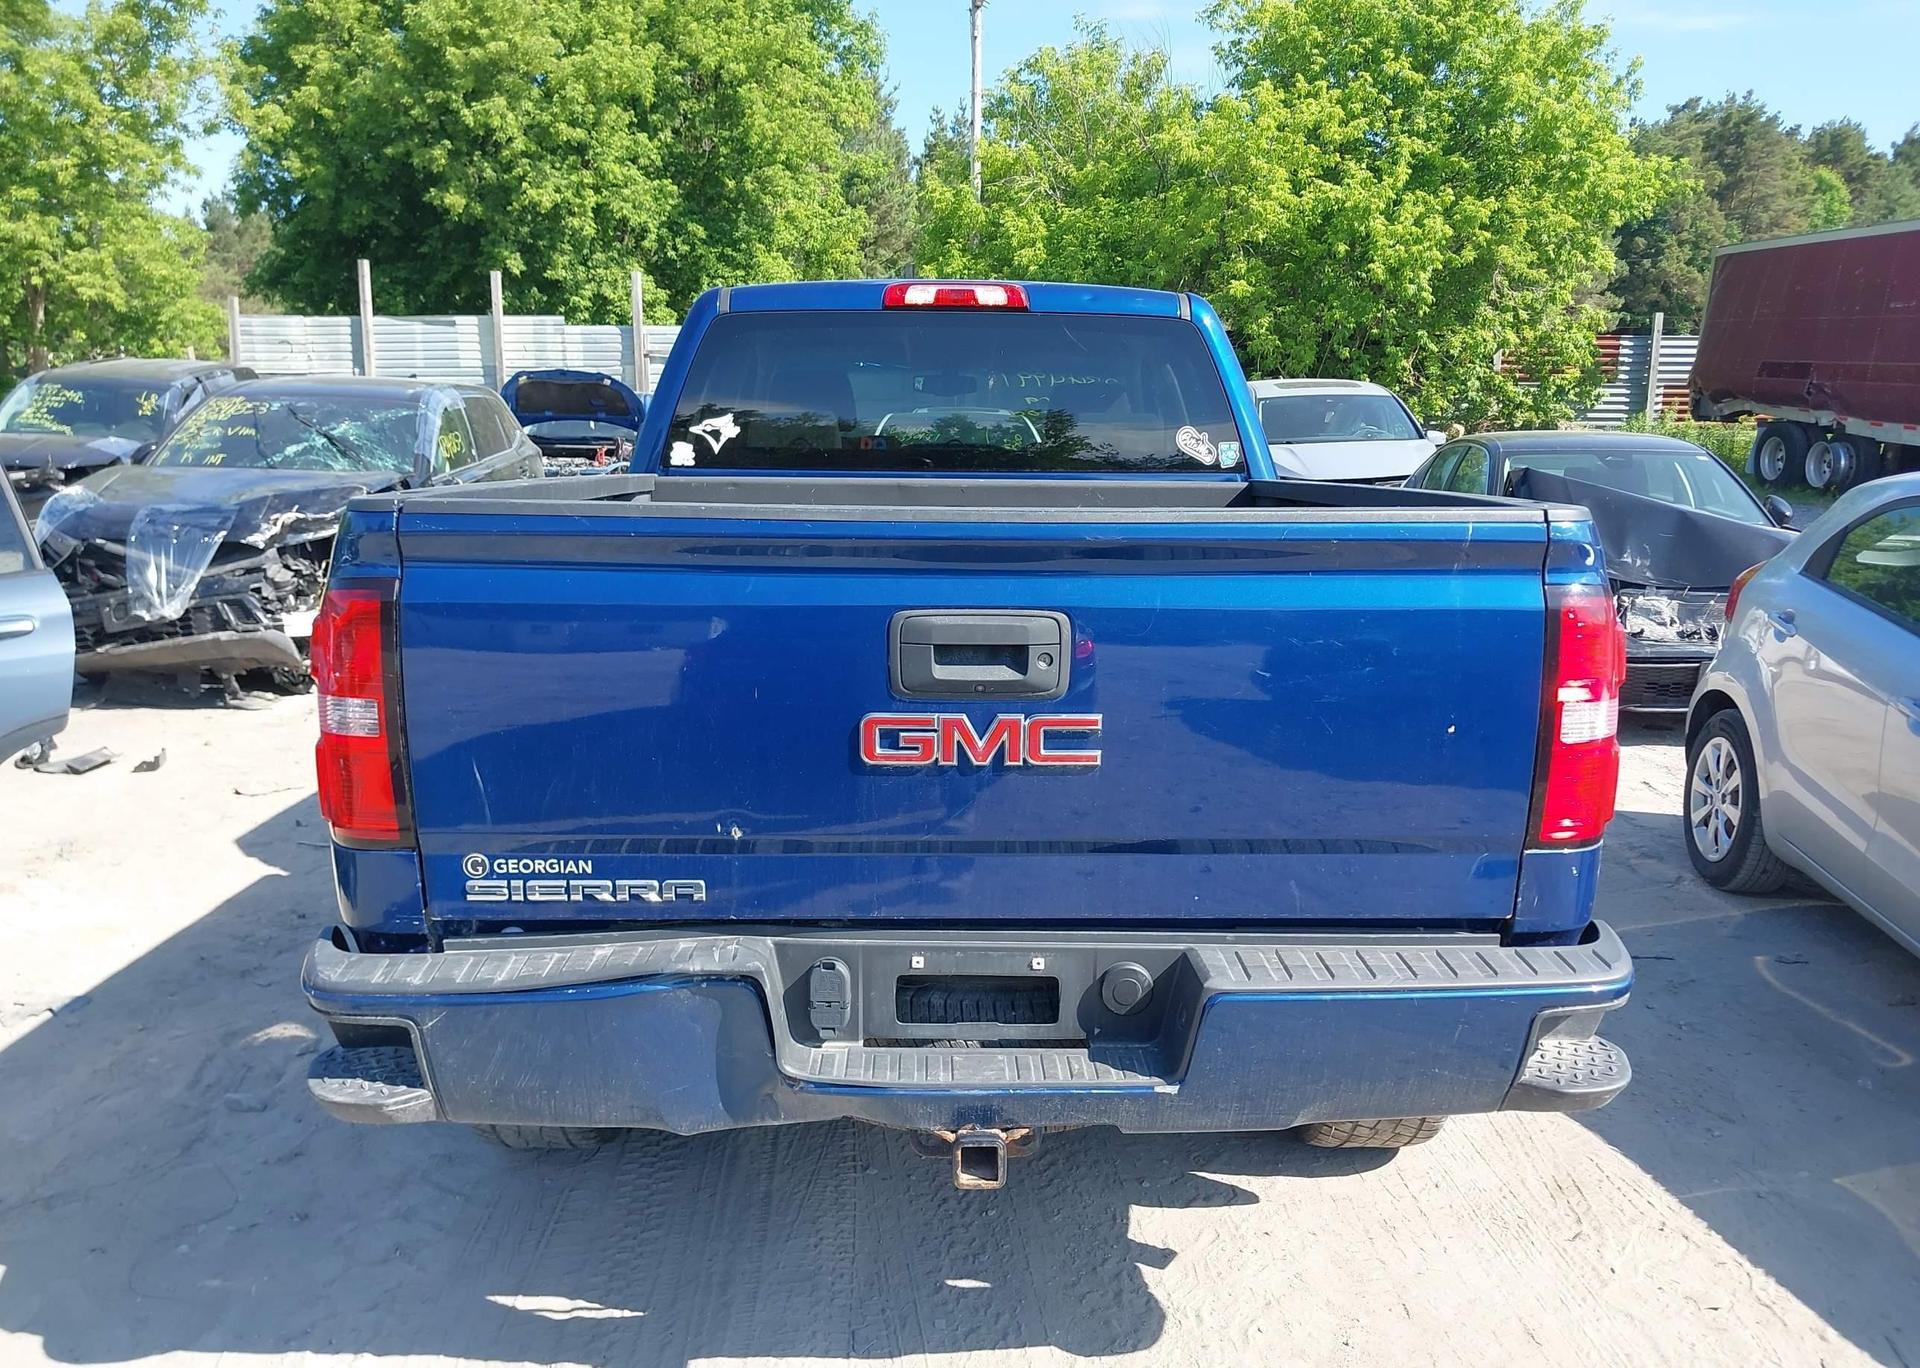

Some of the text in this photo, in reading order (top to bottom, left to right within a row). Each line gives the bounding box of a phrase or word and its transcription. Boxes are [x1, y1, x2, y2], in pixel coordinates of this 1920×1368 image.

[860, 713, 1103, 766] GMC
[493, 858, 593, 875] GEORGIAN
[465, 879, 706, 902] SIERRA
